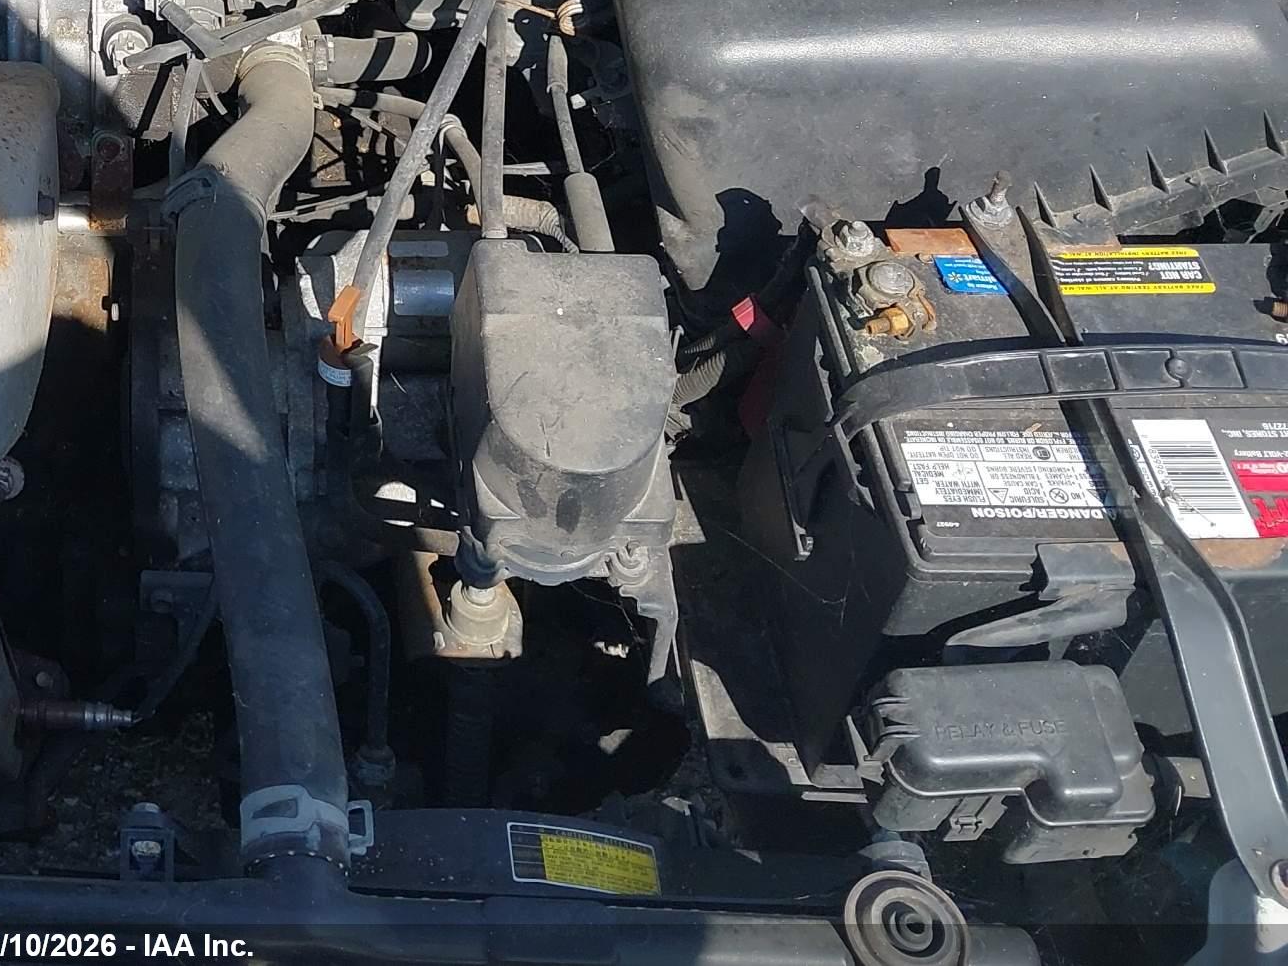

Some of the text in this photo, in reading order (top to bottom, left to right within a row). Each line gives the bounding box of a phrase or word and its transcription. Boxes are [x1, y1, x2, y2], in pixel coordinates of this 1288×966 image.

[1147, 261, 1201, 272] STARTING?
[962, 273, 998, 284] almart
[1158, 270, 1203, 280] CAR NOT
[1234, 449, 1263, 458] Battery
[932, 463, 950, 471] HELP
[1008, 465, 1032, 473] SEVERE
[912, 470, 945, 478] MEDICAL
[916, 477, 930, 485] GET
[960, 480, 981, 488] WITH
[935, 487, 983, 495] IMMEDIATELY
[1023, 487, 1041, 495] ACID
[942, 495, 986, 503] FLUSH EYES
[1008, 495, 1046, 504] SULFURIC
[1070, 492, 1082, 501] NO
[971, 507, 1104, 520] DANGER/POISON
[934, 719, 1066, 740] RELAY & FUSE
